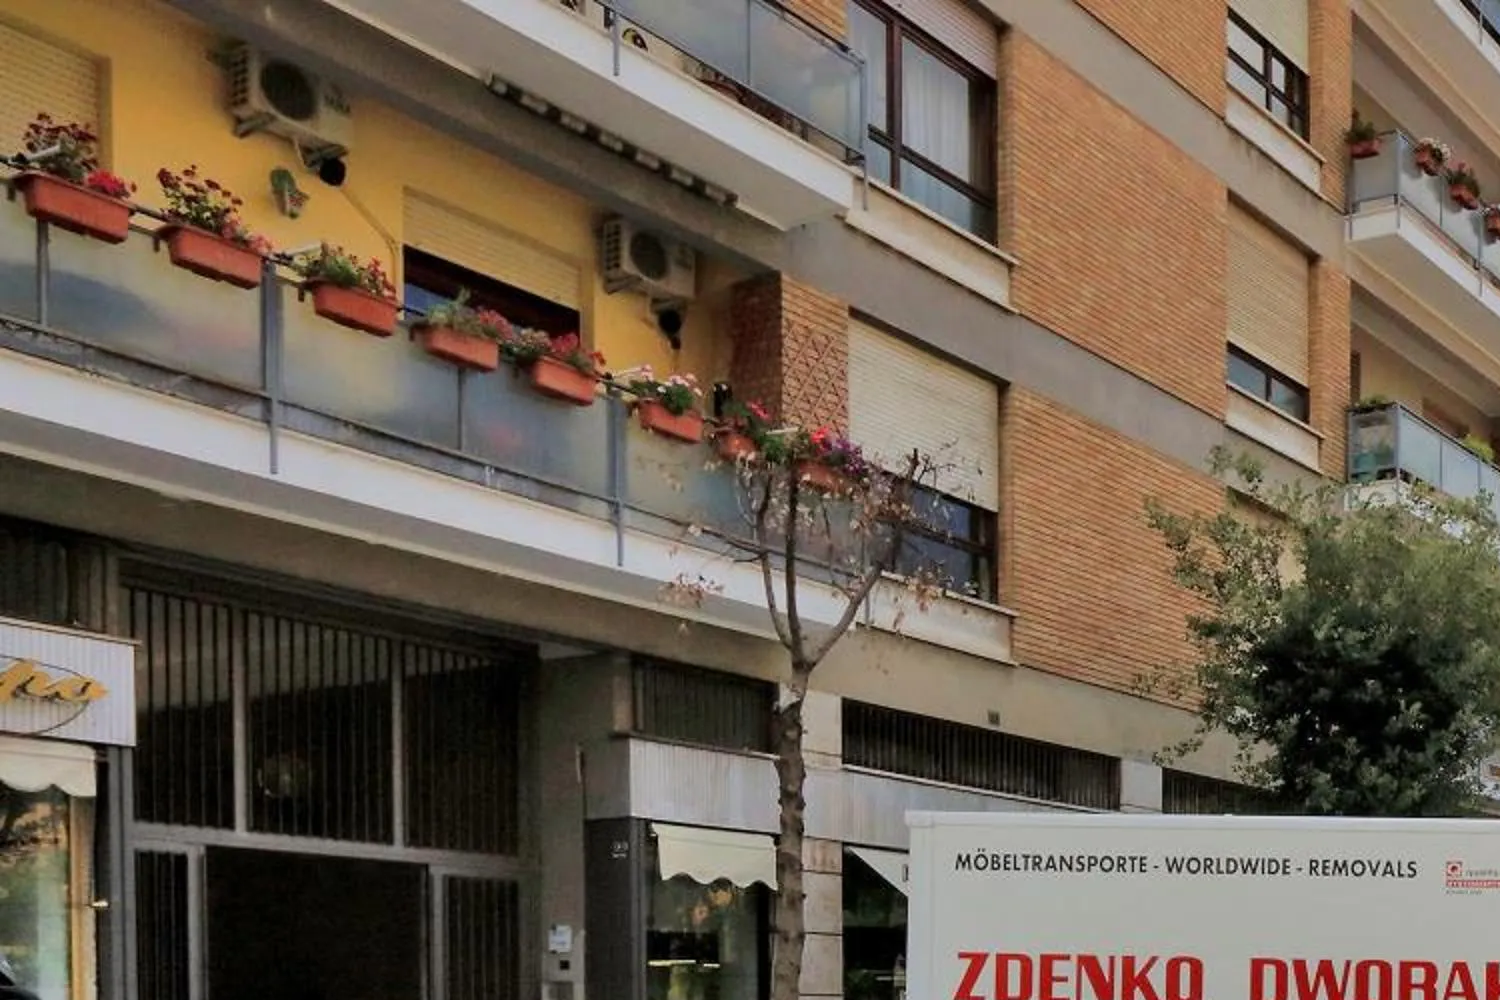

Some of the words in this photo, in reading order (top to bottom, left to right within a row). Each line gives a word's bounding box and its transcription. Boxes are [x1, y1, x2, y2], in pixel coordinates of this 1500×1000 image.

[954, 848, 1148, 874] MÖBELTRANSPORTE
[1164, 856, 1291, 876] WORLDWIDE
[1308, 859, 1418, 878] REMOVALS
